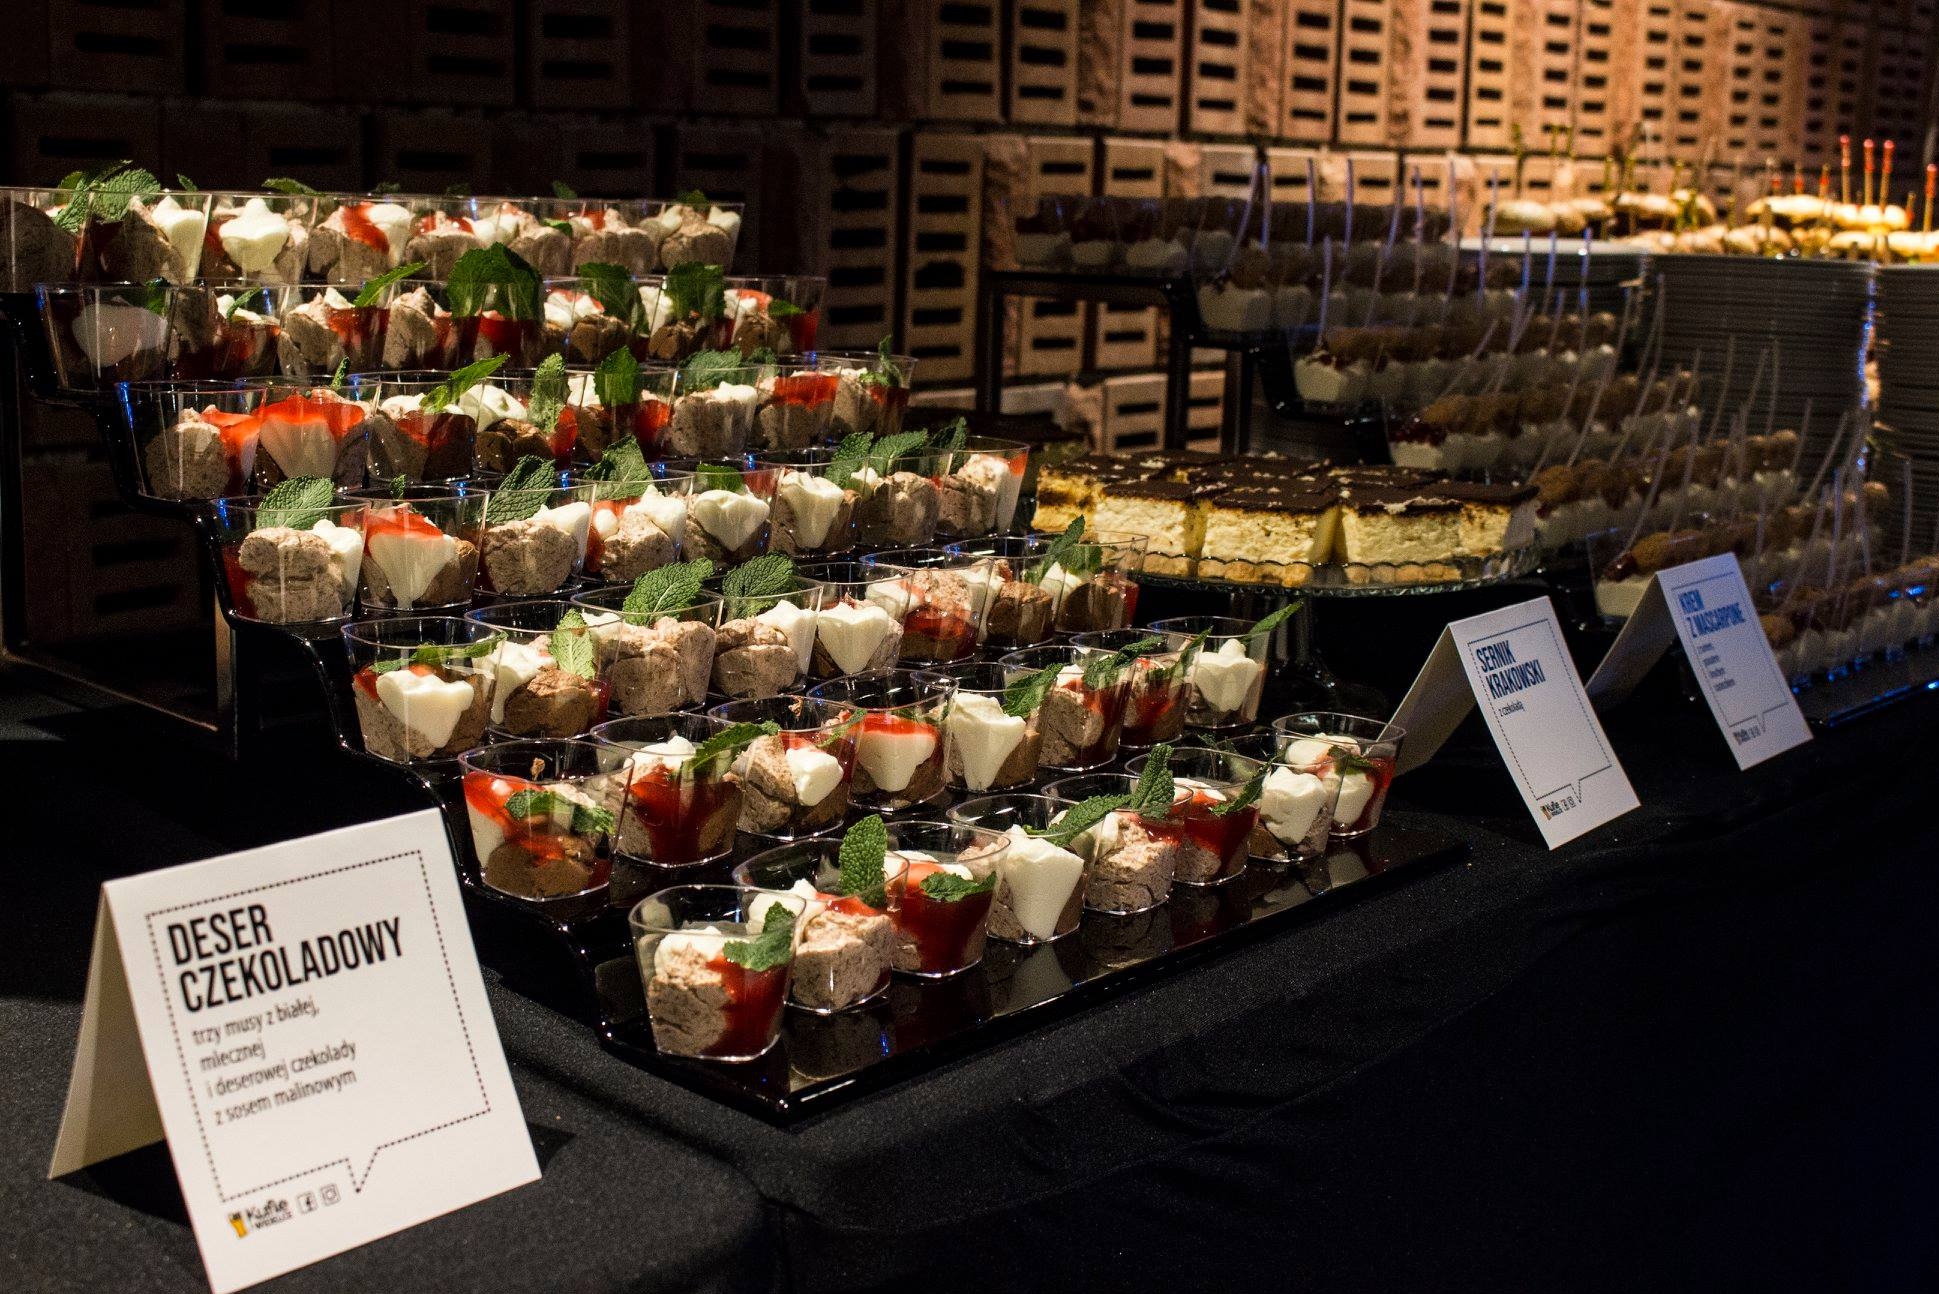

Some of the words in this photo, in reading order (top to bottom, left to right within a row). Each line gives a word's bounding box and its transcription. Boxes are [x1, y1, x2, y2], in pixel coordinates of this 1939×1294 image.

[1693, 602, 1746, 635] MASCARPONE
[1475, 639, 1516, 673] SERNIK
[1486, 659, 1546, 700] KRAKOWSKI
[167, 903, 273, 966] DESER
[179, 917, 403, 1012] CZEKOLADOWY
[192, 1025, 221, 1046] trzy
[225, 1014, 263, 1037] musy
[266, 1010, 275, 1026] z
[275, 995, 320, 1022] białej,
[200, 1038, 266, 1072] mlecznej
[207, 1081, 213, 1099] i
[216, 1059, 290, 1097] deserowej
[291, 1039, 356, 1073] czekolady
[214, 1110, 223, 1126] z
[226, 1096, 272, 1123] sosem
[274, 1069, 357, 1106] malinowym
